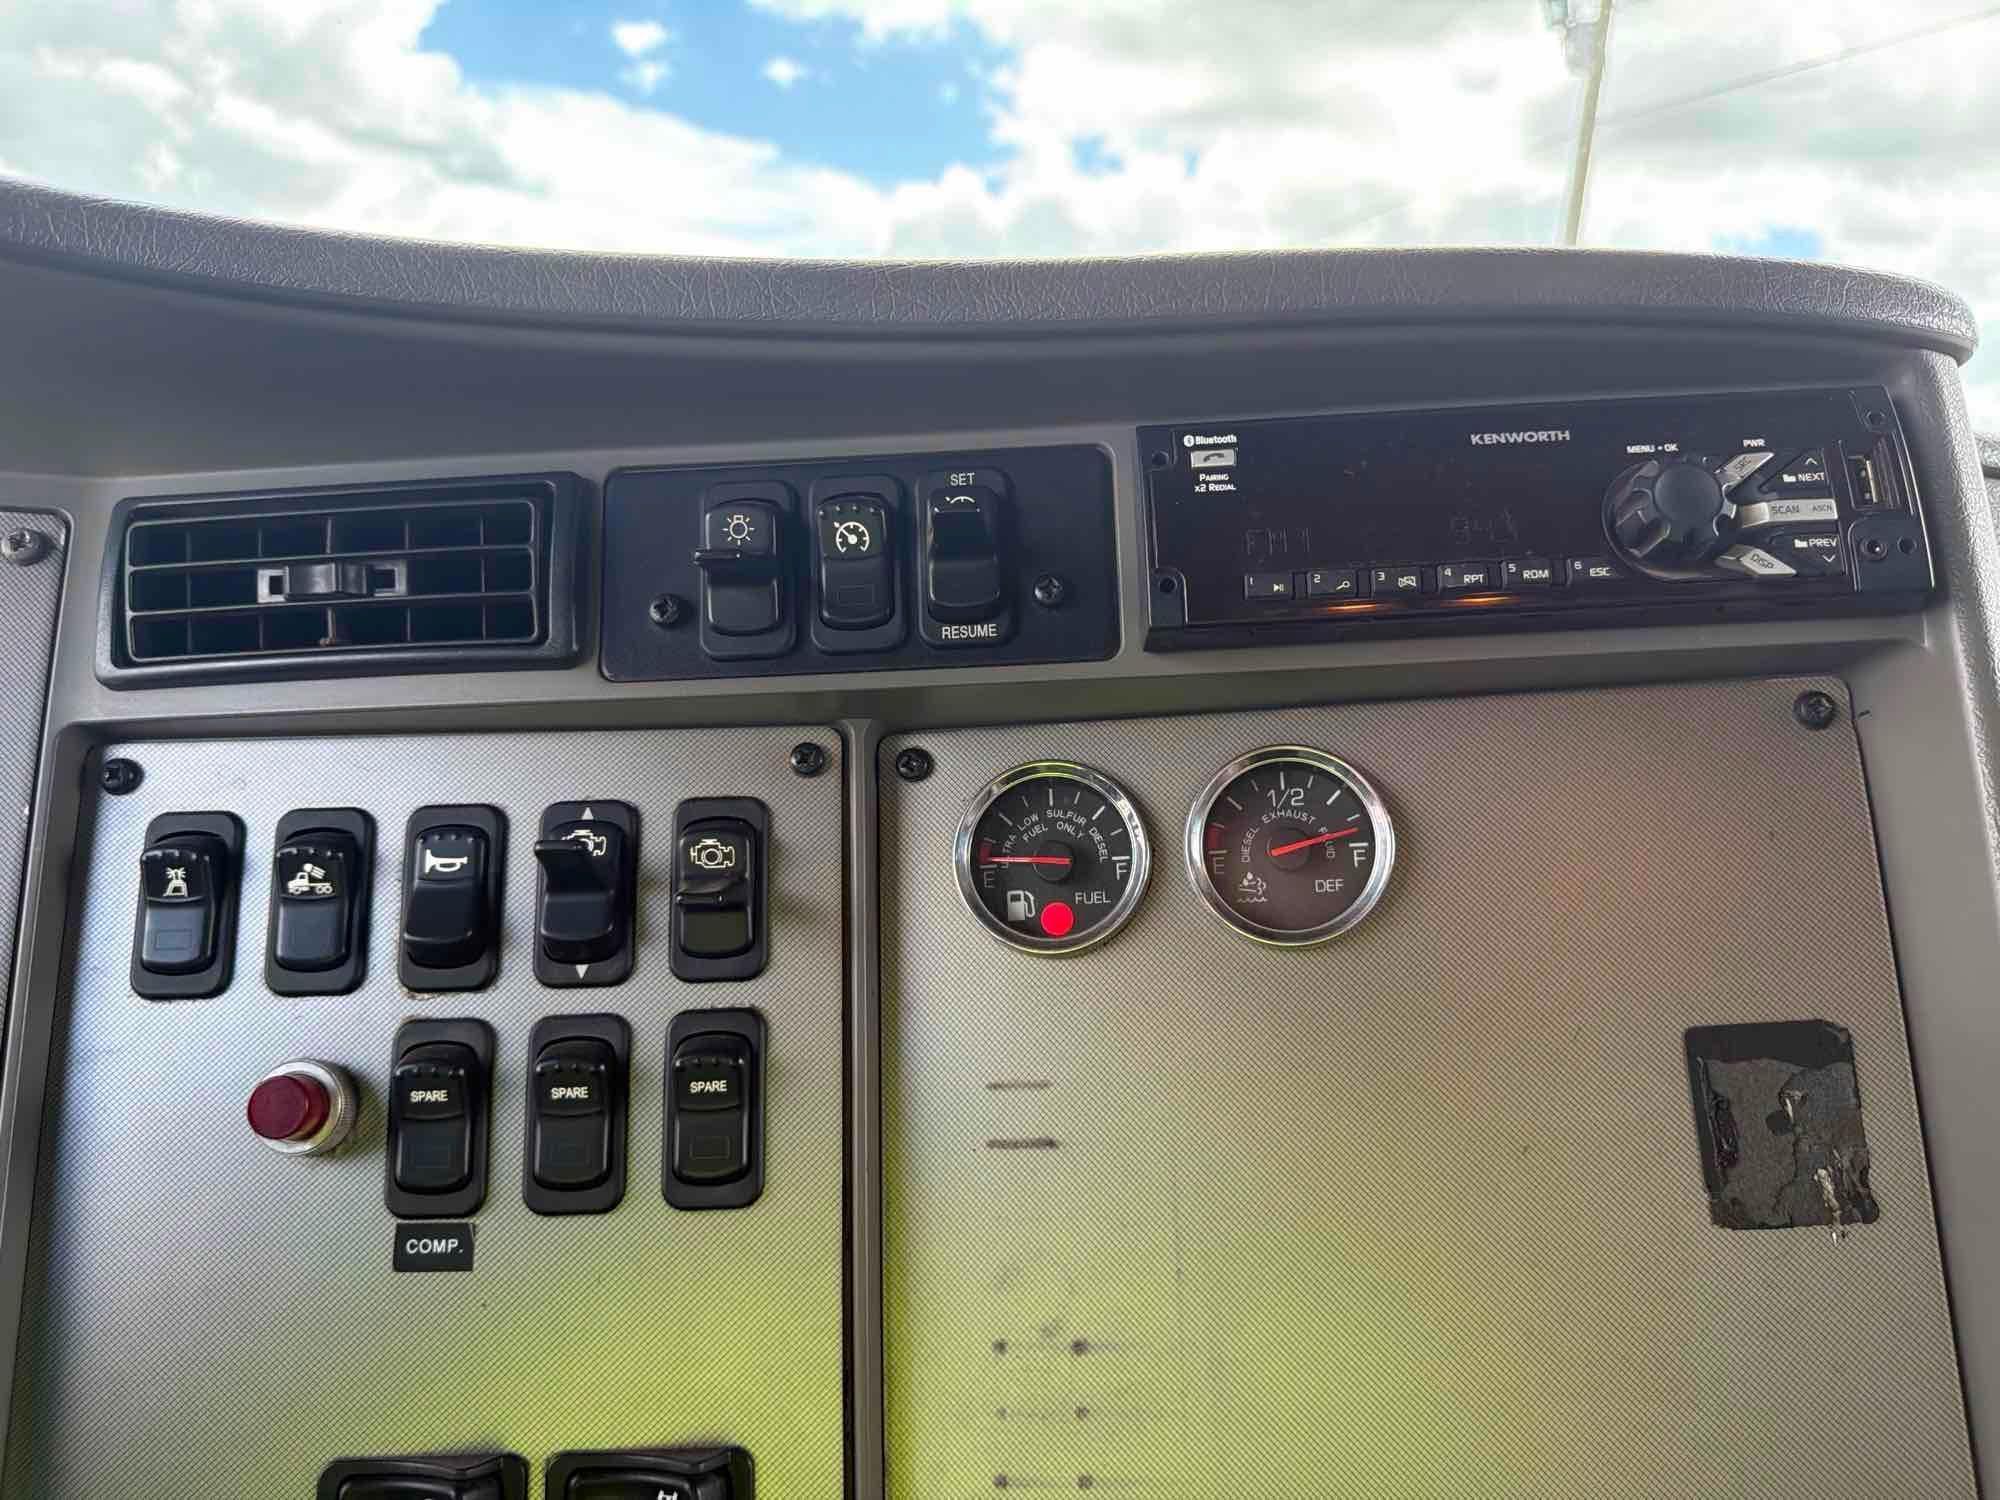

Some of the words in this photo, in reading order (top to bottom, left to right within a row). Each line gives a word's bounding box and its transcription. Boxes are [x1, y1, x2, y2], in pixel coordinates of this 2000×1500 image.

[1195, 434, 1238, 446] Bluetooth
[1470, 430, 1571, 446] KENWORTH
[1743, 438, 1766, 448] PWR
[1626, 444, 1656, 454] MENU
[1664, 442, 1679, 452] OK
[950, 472, 975, 486] SET
[1797, 472, 1825, 482] NEXT
[1771, 503, 1800, 513] SCAN
[1808, 537, 1838, 548] PREV
[1313, 574, 1321, 583] 2
[1376, 571, 1385, 581] 3
[1444, 567, 1452, 577] 4
[1463, 572, 1484, 584] RPT
[1508, 563, 1516, 572] 5
[1523, 567, 1550, 581] RDM
[1589, 567, 1612, 577] ESC
[941, 623, 998, 640] RESUME
[1267, 787, 1305, 809] 1/2
[1017, 812, 1040, 831] LOW
[1046, 809, 1087, 826] SULFUR
[1023, 823, 1049, 843] FUEL
[1056, 820, 1085, 840] ONLY
[1240, 825, 1260, 863] DIESEL
[1262, 808, 1316, 825] EXHAUST
[1353, 849, 1367, 868] F
[1115, 862, 1128, 880] F
[1315, 878, 1345, 893] DEF
[1075, 890, 1111, 905] FUEL
[551, 1086, 589, 1099] SPARE
[690, 1080, 728, 1094] SPARE
[410, 1089, 449, 1103] SPARE
[405, 1239, 464, 1254] COMP.
